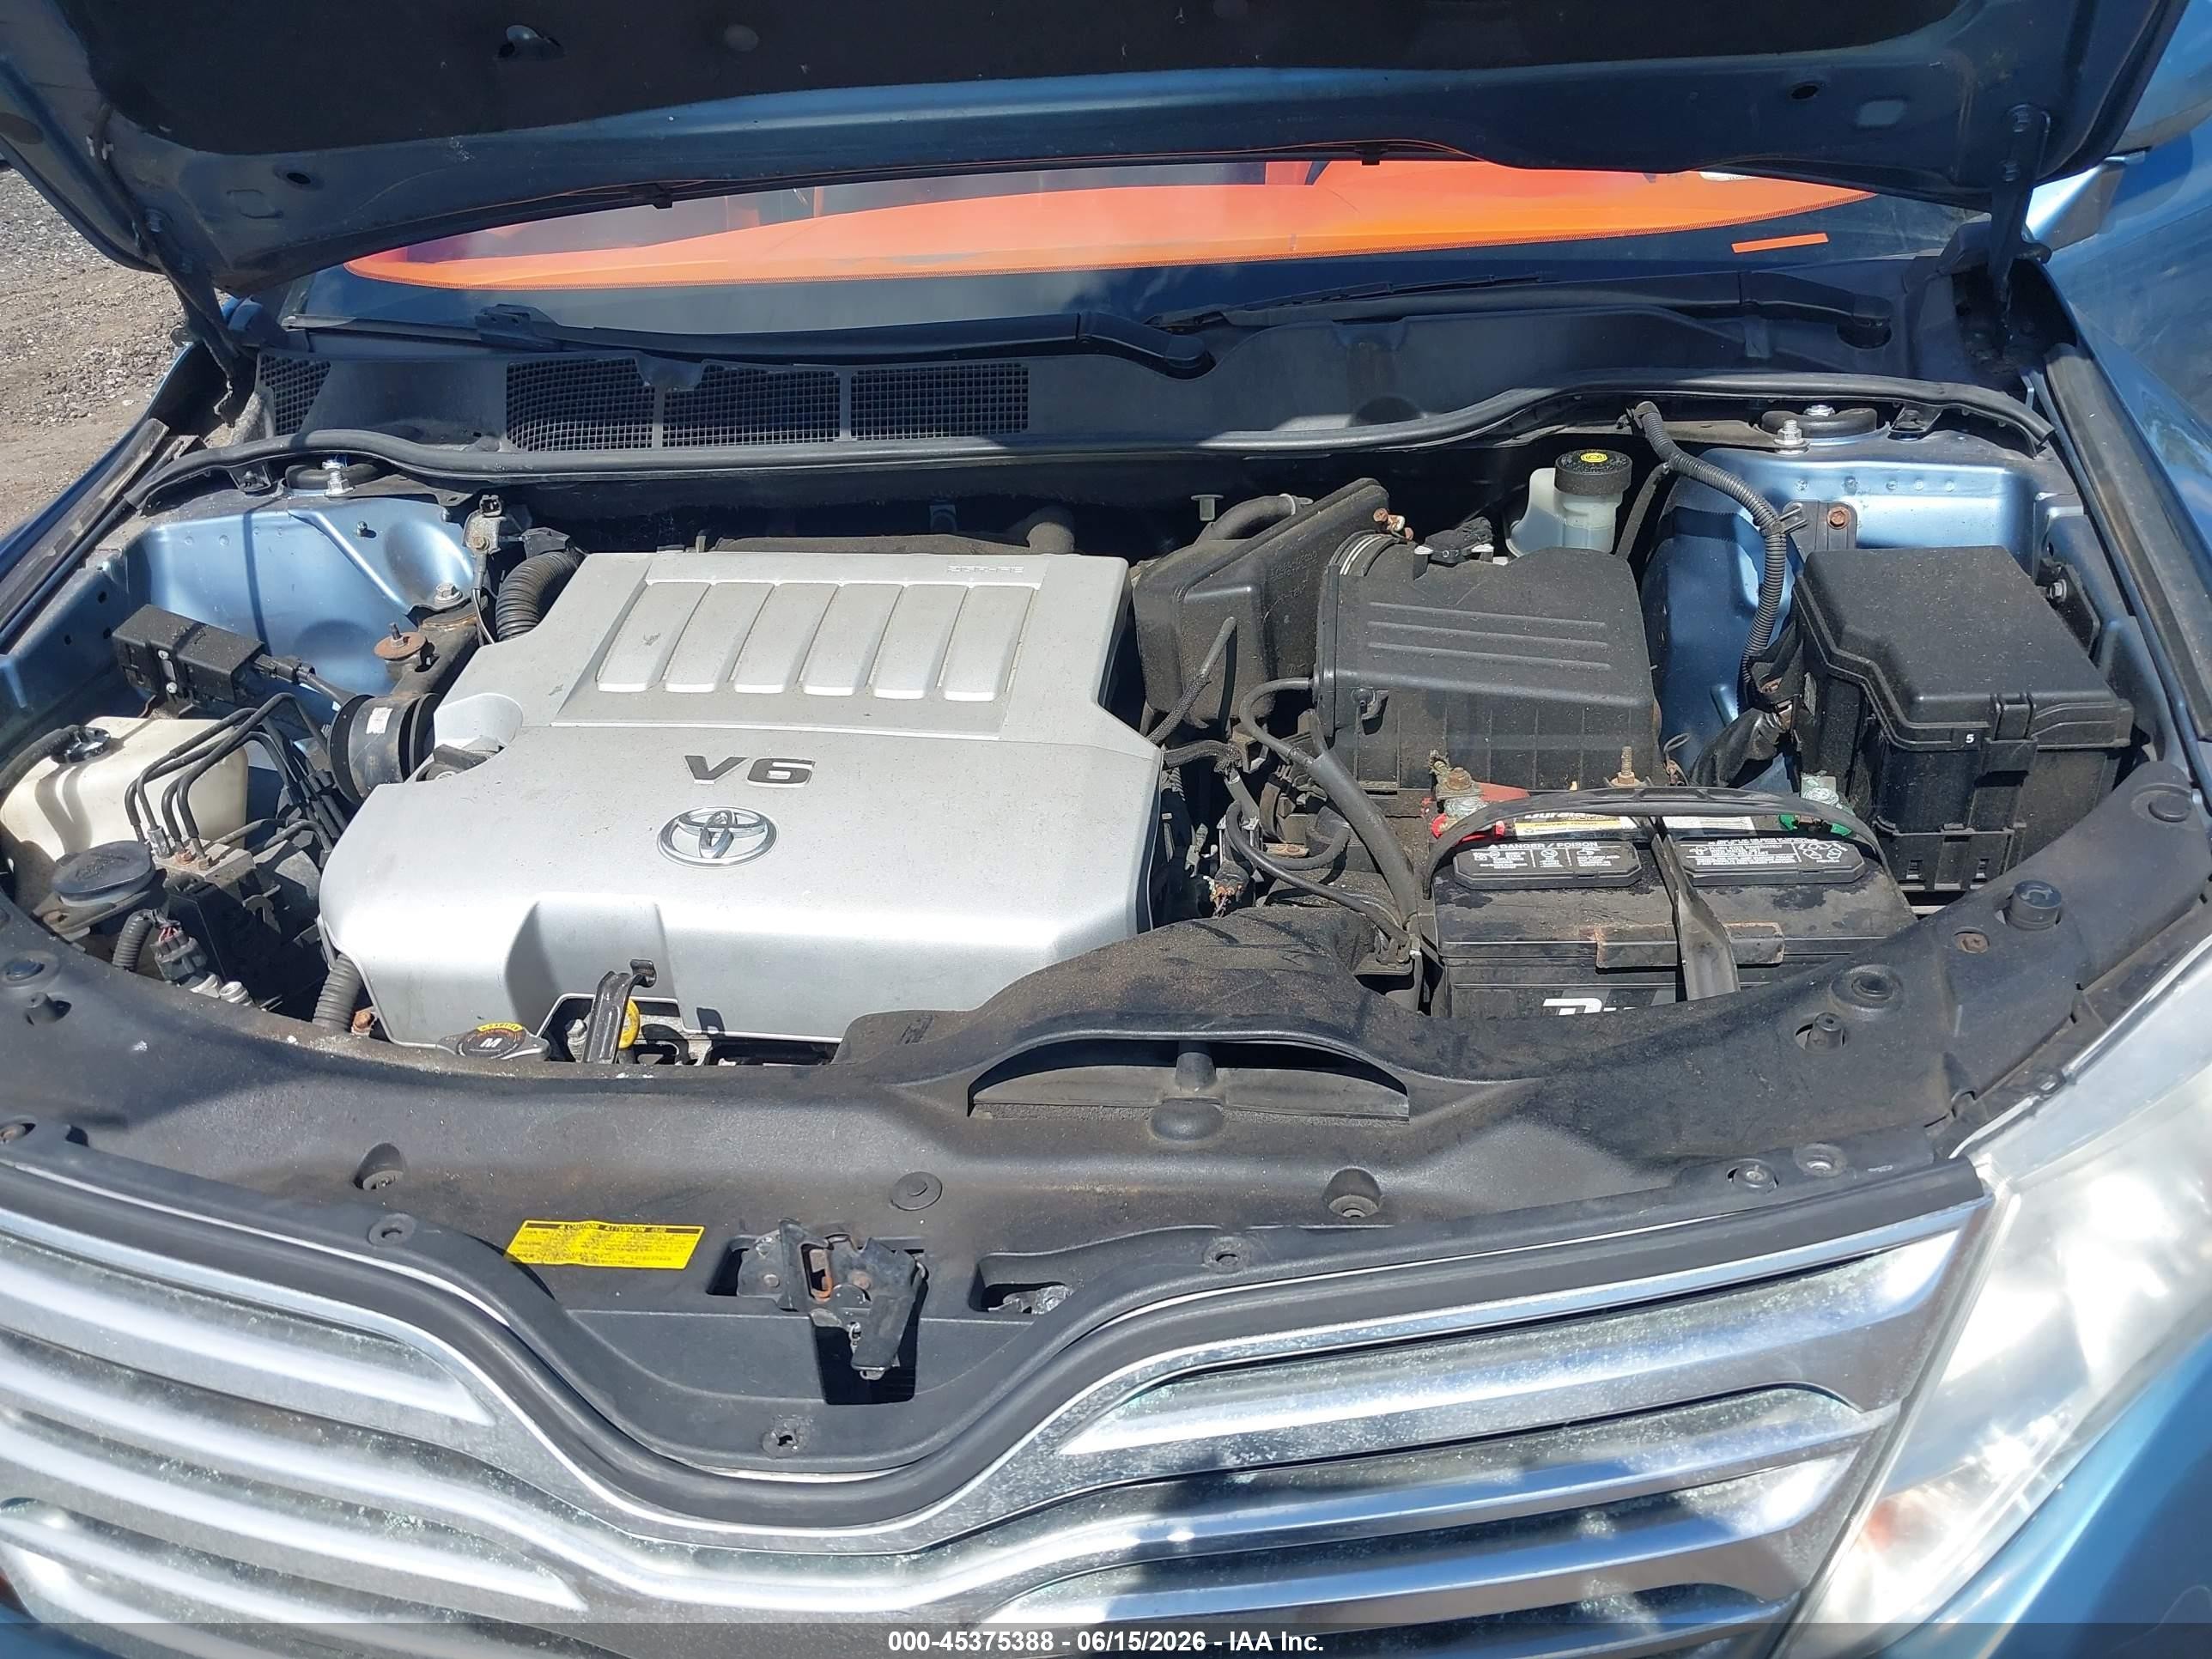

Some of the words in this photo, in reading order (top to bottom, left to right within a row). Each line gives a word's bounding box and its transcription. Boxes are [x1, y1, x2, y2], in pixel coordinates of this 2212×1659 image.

[1966, 733, 1974, 744] 5
[684, 755, 816, 788] V6
[479, 1037, 503, 1048] M
